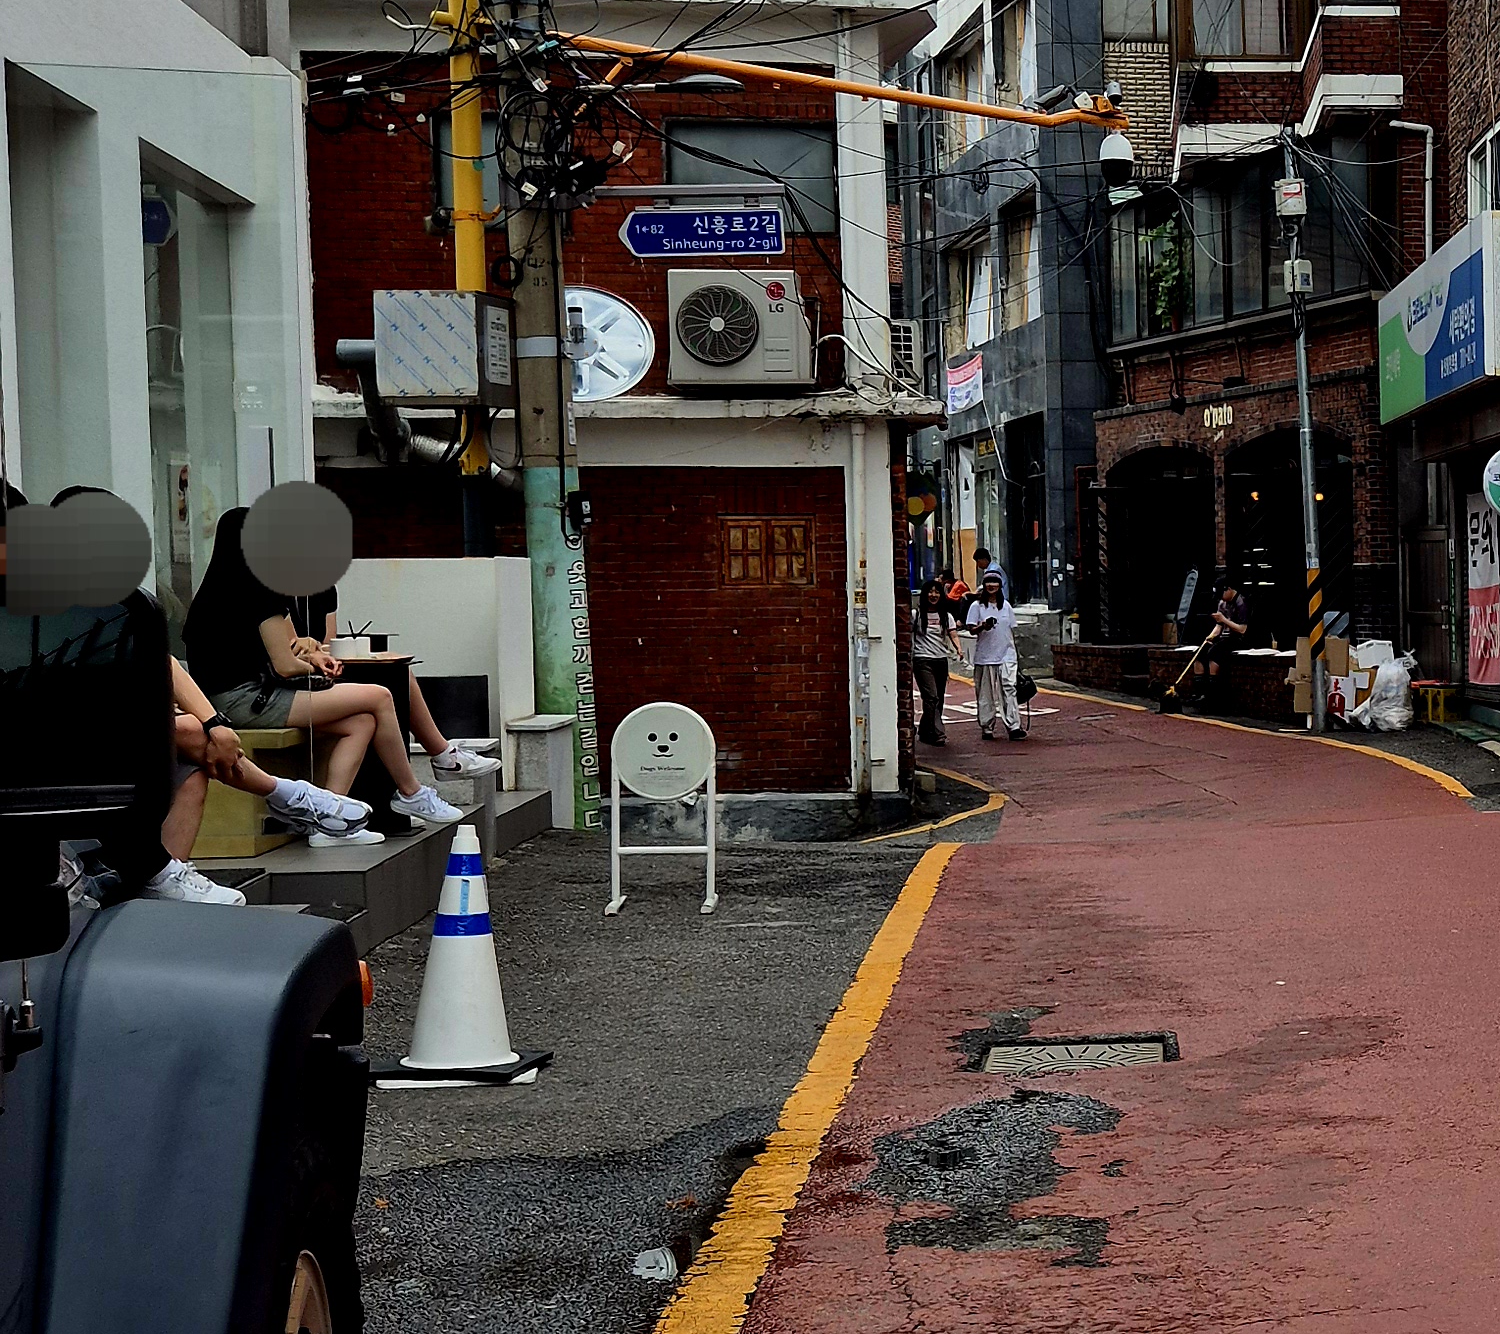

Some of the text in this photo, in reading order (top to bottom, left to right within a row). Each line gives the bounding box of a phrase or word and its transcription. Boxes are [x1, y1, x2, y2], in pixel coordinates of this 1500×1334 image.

[650, 224, 665, 234] 82
[692, 215, 777, 235] 신흥로2길
[662, 236, 778, 251] Sinheung-ro 2-gil
[768, 303, 784, 313] LG
